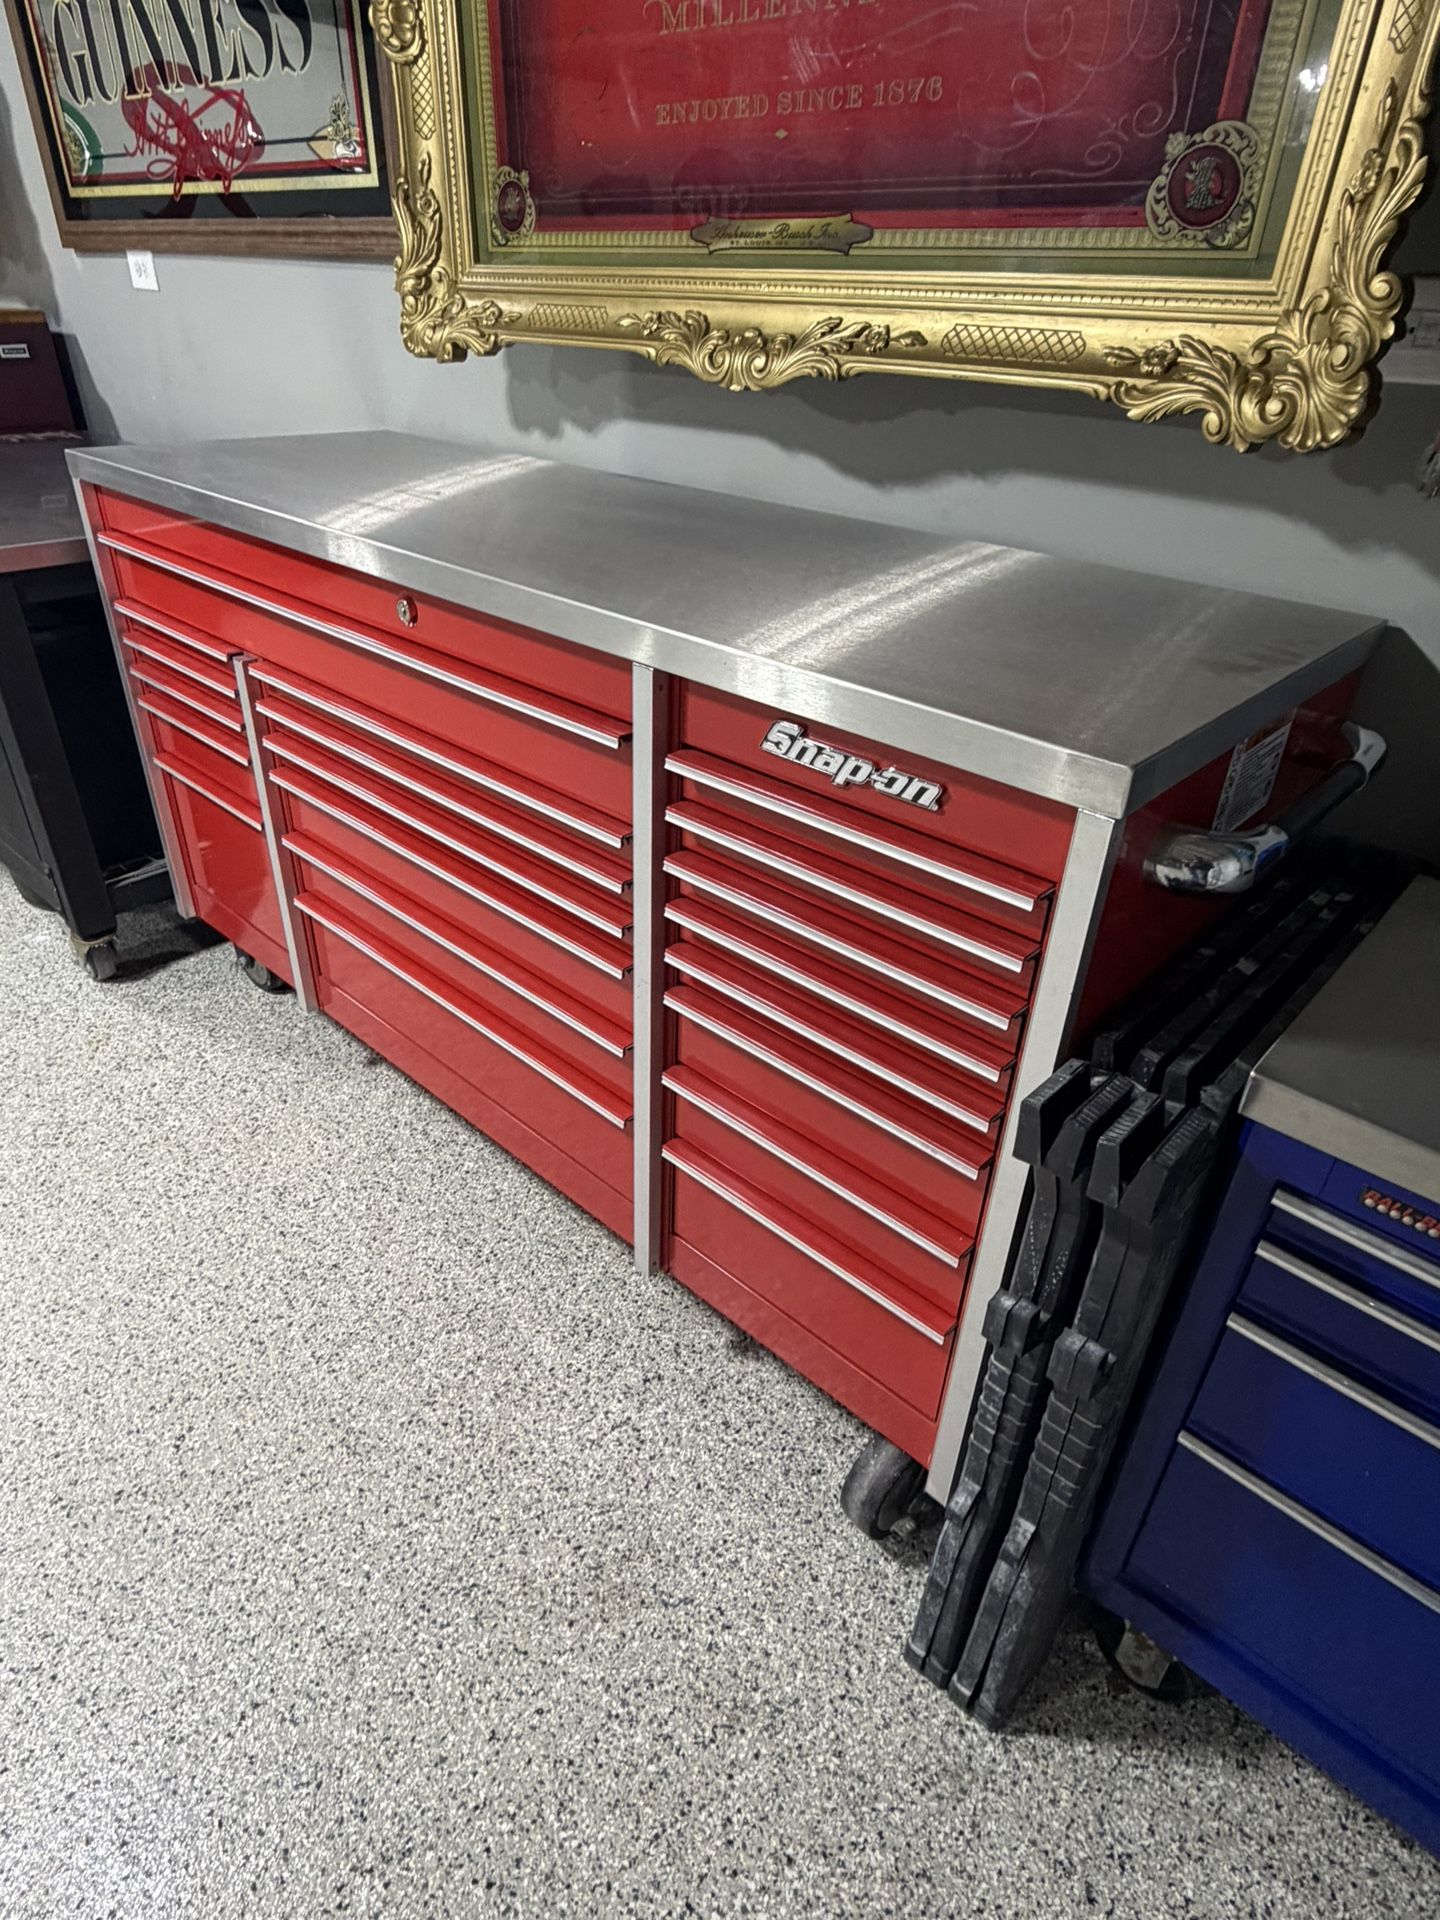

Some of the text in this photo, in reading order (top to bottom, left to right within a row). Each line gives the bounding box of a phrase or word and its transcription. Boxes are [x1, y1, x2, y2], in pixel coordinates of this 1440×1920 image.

[53, 0, 312, 107] GUINNESS
[655, 76, 943, 125] ENJOYED SINCE 1876
[760, 719, 943, 812] Snap-on
